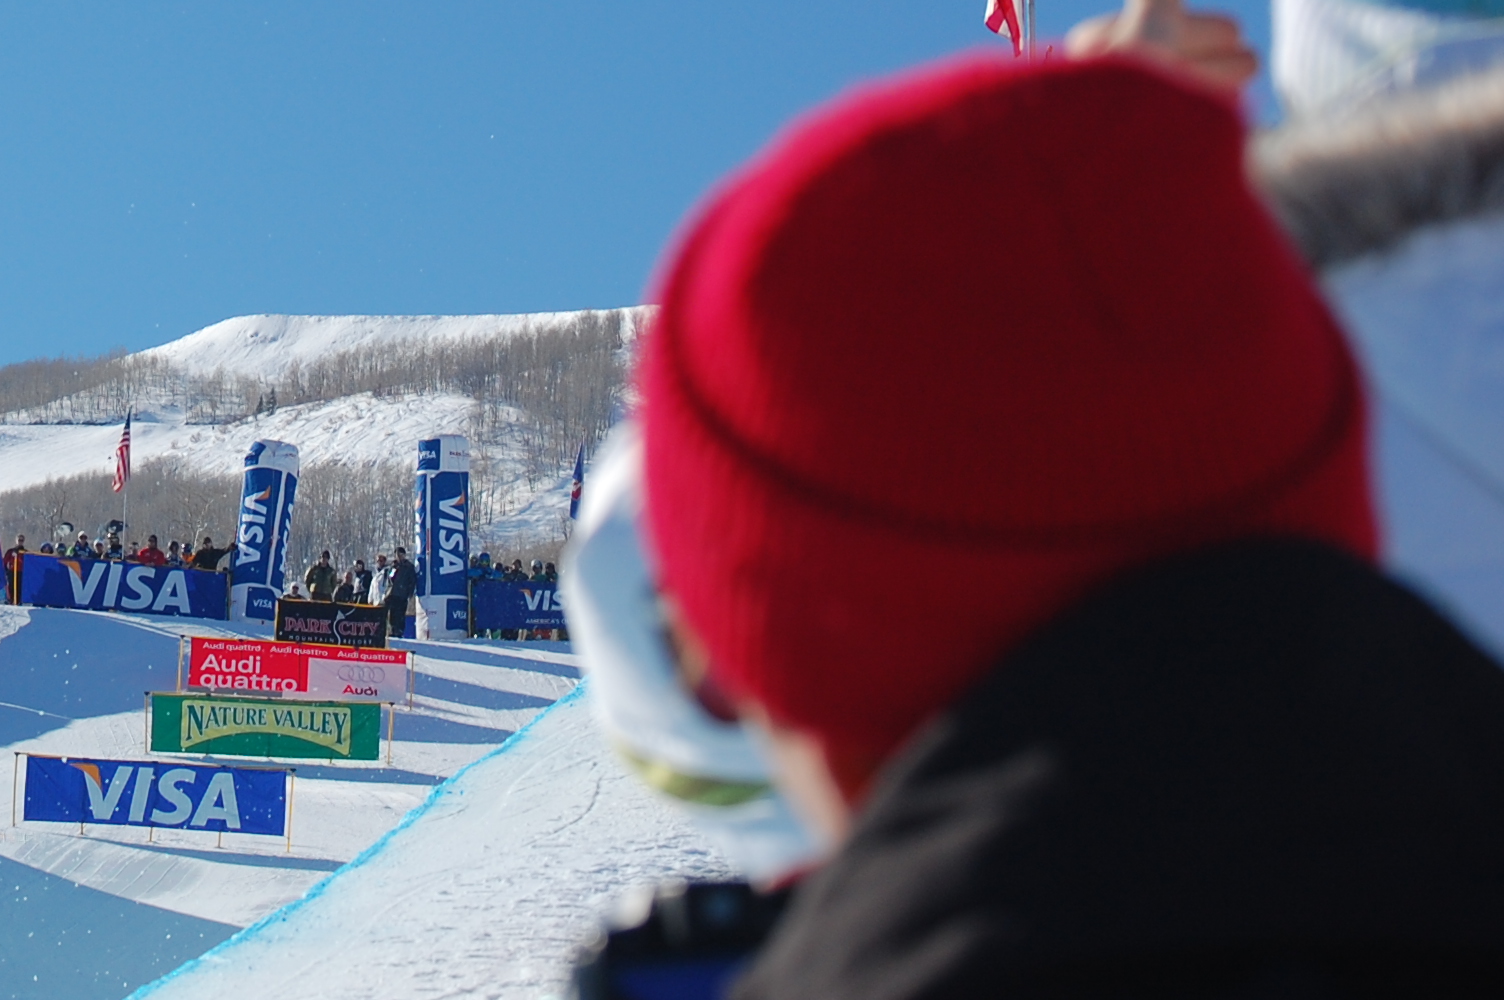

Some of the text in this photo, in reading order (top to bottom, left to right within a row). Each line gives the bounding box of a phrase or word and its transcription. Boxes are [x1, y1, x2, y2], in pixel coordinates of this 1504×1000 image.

[236, 485, 272, 567] VISA
[438, 491, 466, 576] VISA
[57, 559, 191, 614] VISA
[253, 599, 273, 610] VISA
[518, 588, 565, 611] VIS
[284, 616, 380, 637] PARK CITY
[202, 641, 262, 653] Audi quattro
[269, 645, 329, 658] Audi quattro
[337, 650, 396, 662] Audi quattro
[200, 653, 261, 675] Audi
[199, 673, 298, 692] quattro
[342, 684, 378, 697] Audi
[185, 704, 349, 746] NATURE VALLEY
[69, 762, 242, 830] VISA
